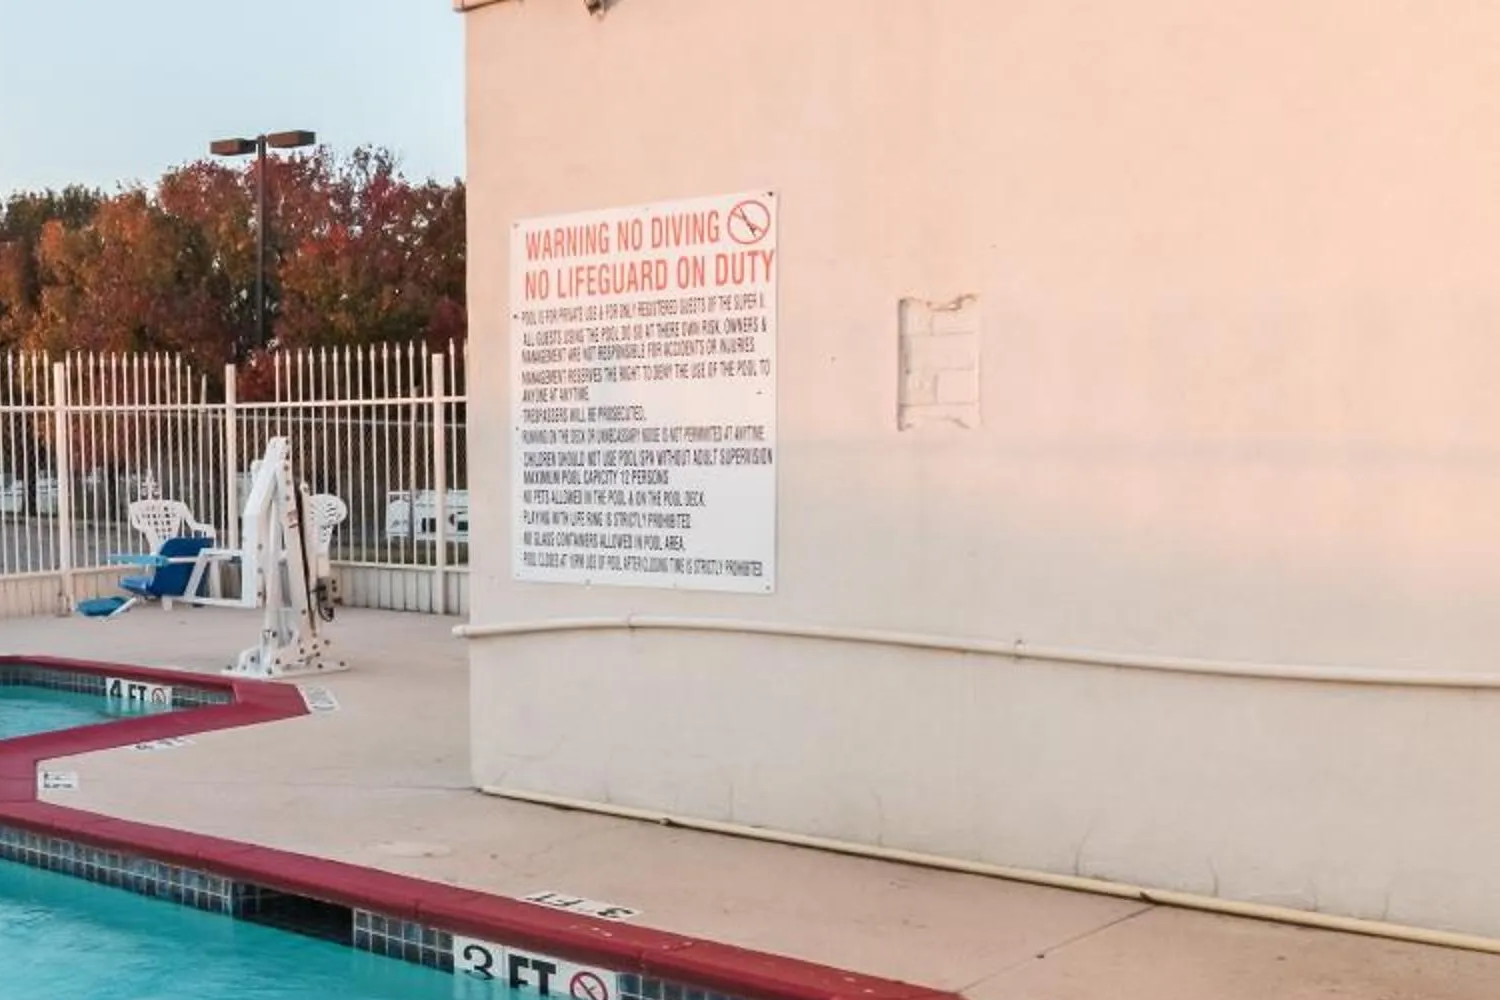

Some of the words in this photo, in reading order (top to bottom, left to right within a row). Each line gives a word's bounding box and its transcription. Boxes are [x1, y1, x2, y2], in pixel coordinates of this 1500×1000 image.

[526, 223, 609, 261] WARNING
[617, 219, 643, 251] NO
[650, 210, 720, 249] DIVING
[525, 269, 549, 300] NO
[557, 259, 668, 298] LIFEGUARD
[677, 255, 706, 289] ON
[715, 249, 775, 286] DUTY
[718, 295, 731, 311] THE
[674, 363, 689, 379] THE
[719, 361, 734, 378] THE
[759, 359, 770, 376] TO
[631, 469, 669, 484] PERSONS
[110, 680, 122, 698] 4
[128, 684, 148, 701] FT
[463, 944, 494, 980] 3
[508, 953, 556, 996] FT
